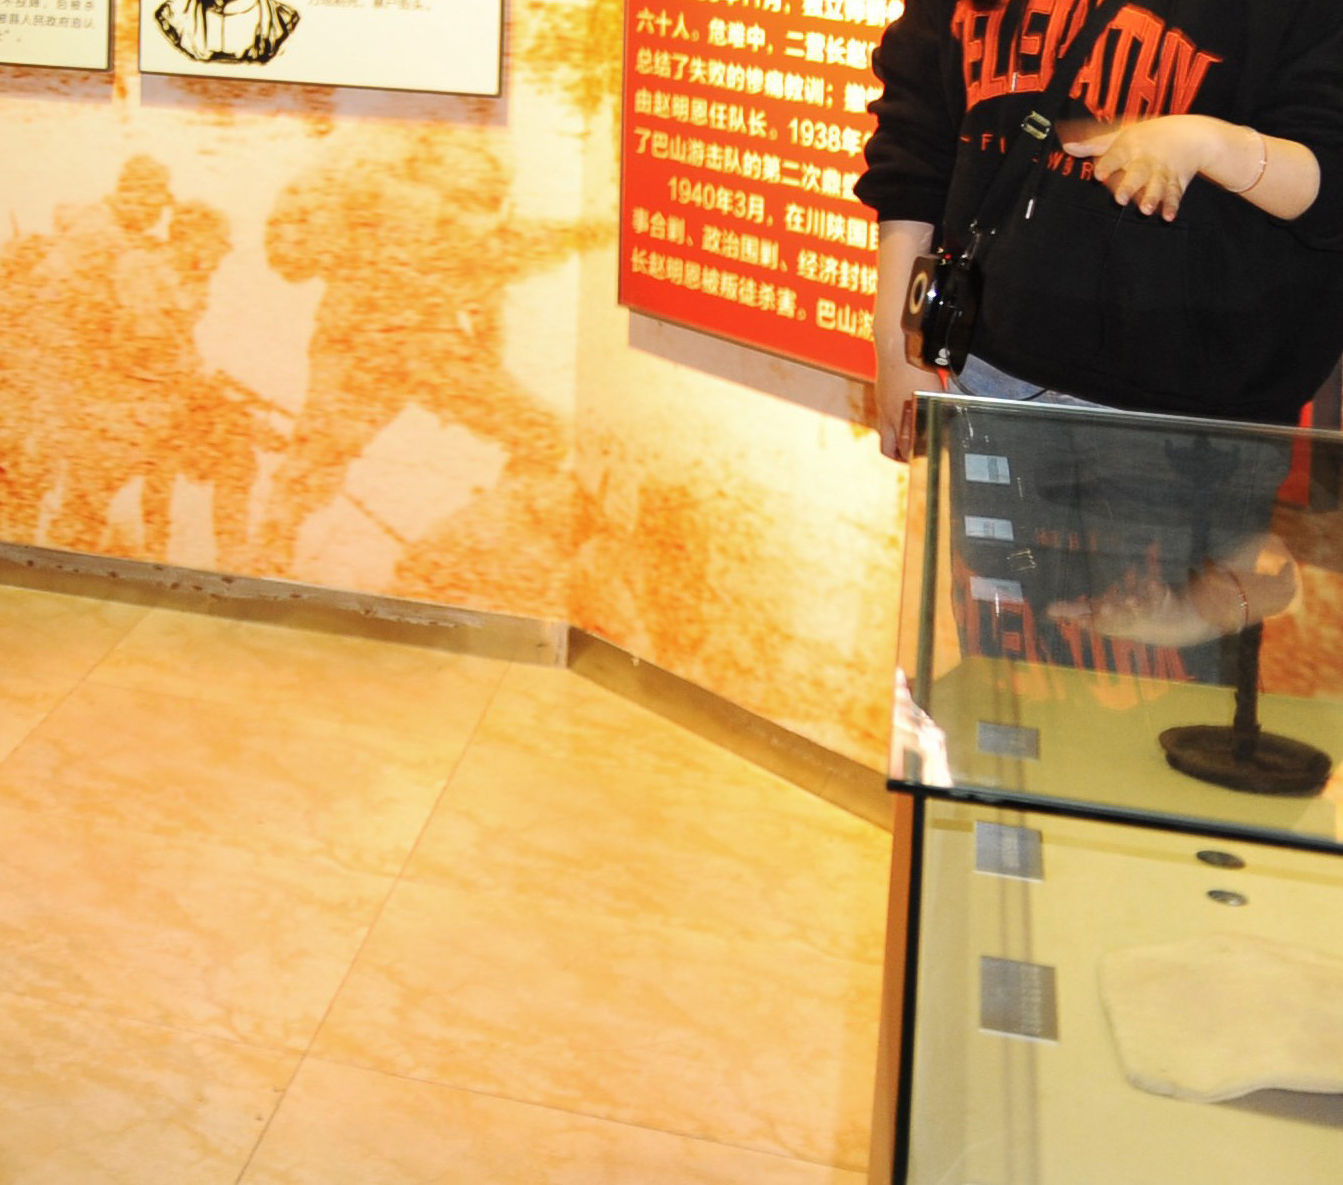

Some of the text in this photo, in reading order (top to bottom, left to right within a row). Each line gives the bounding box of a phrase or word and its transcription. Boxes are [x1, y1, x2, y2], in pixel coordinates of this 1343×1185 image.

[635, 7, 877, 70] 六十人。危难中，二营长赵
[634, 88, 873, 153] 由赵明恩任队长。1938年
